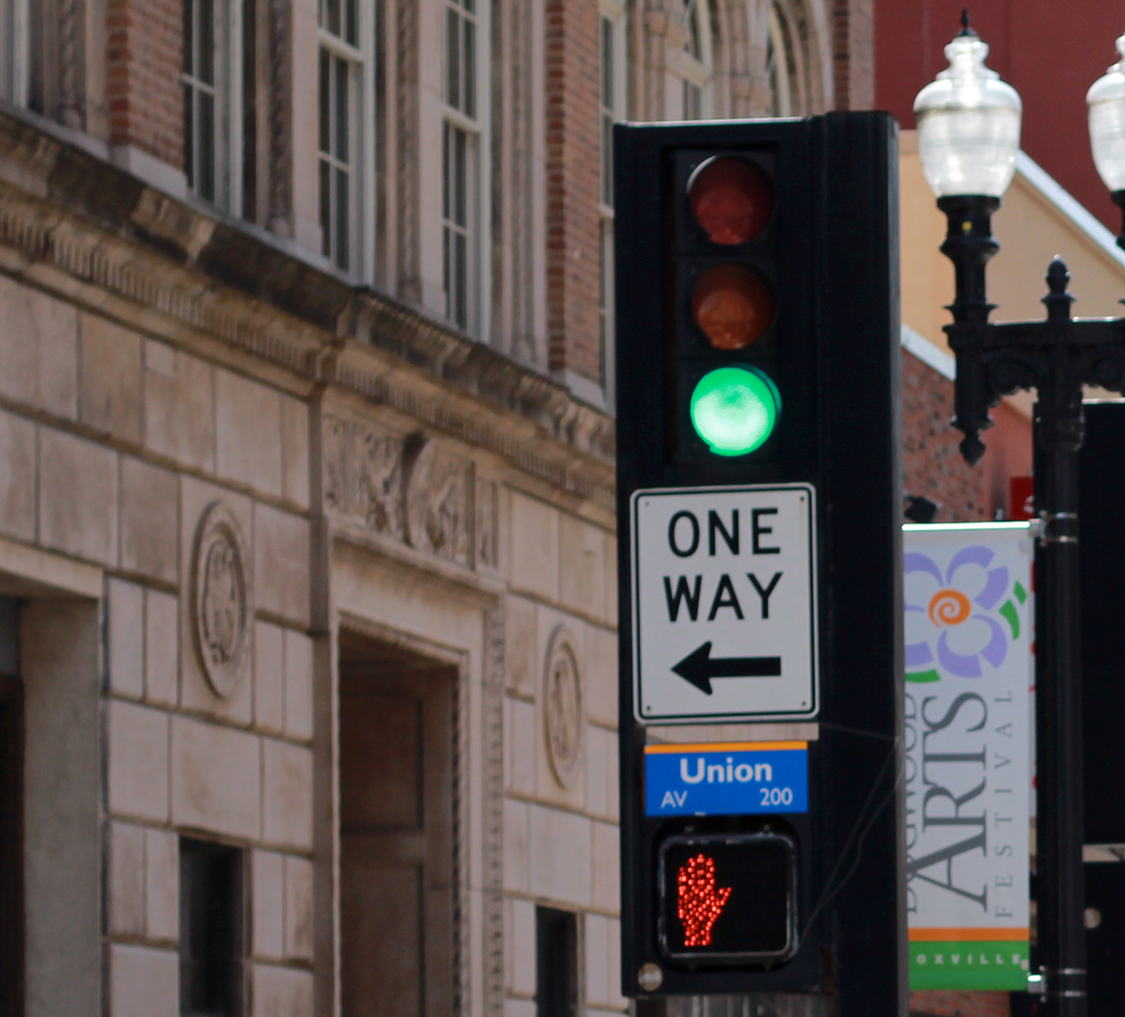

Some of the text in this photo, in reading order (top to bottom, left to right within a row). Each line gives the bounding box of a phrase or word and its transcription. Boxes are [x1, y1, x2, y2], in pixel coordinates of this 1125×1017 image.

[667, 507, 781, 558] ONE
[663, 571, 783, 622] WAY
[679, 757, 773, 785] Union
[661, 788, 793, 808] AV 200
[906, 691, 988, 913] ARTS
[994, 690, 1013, 918] FESTIVAL
[916, 954, 1021, 965] OXVILLE
